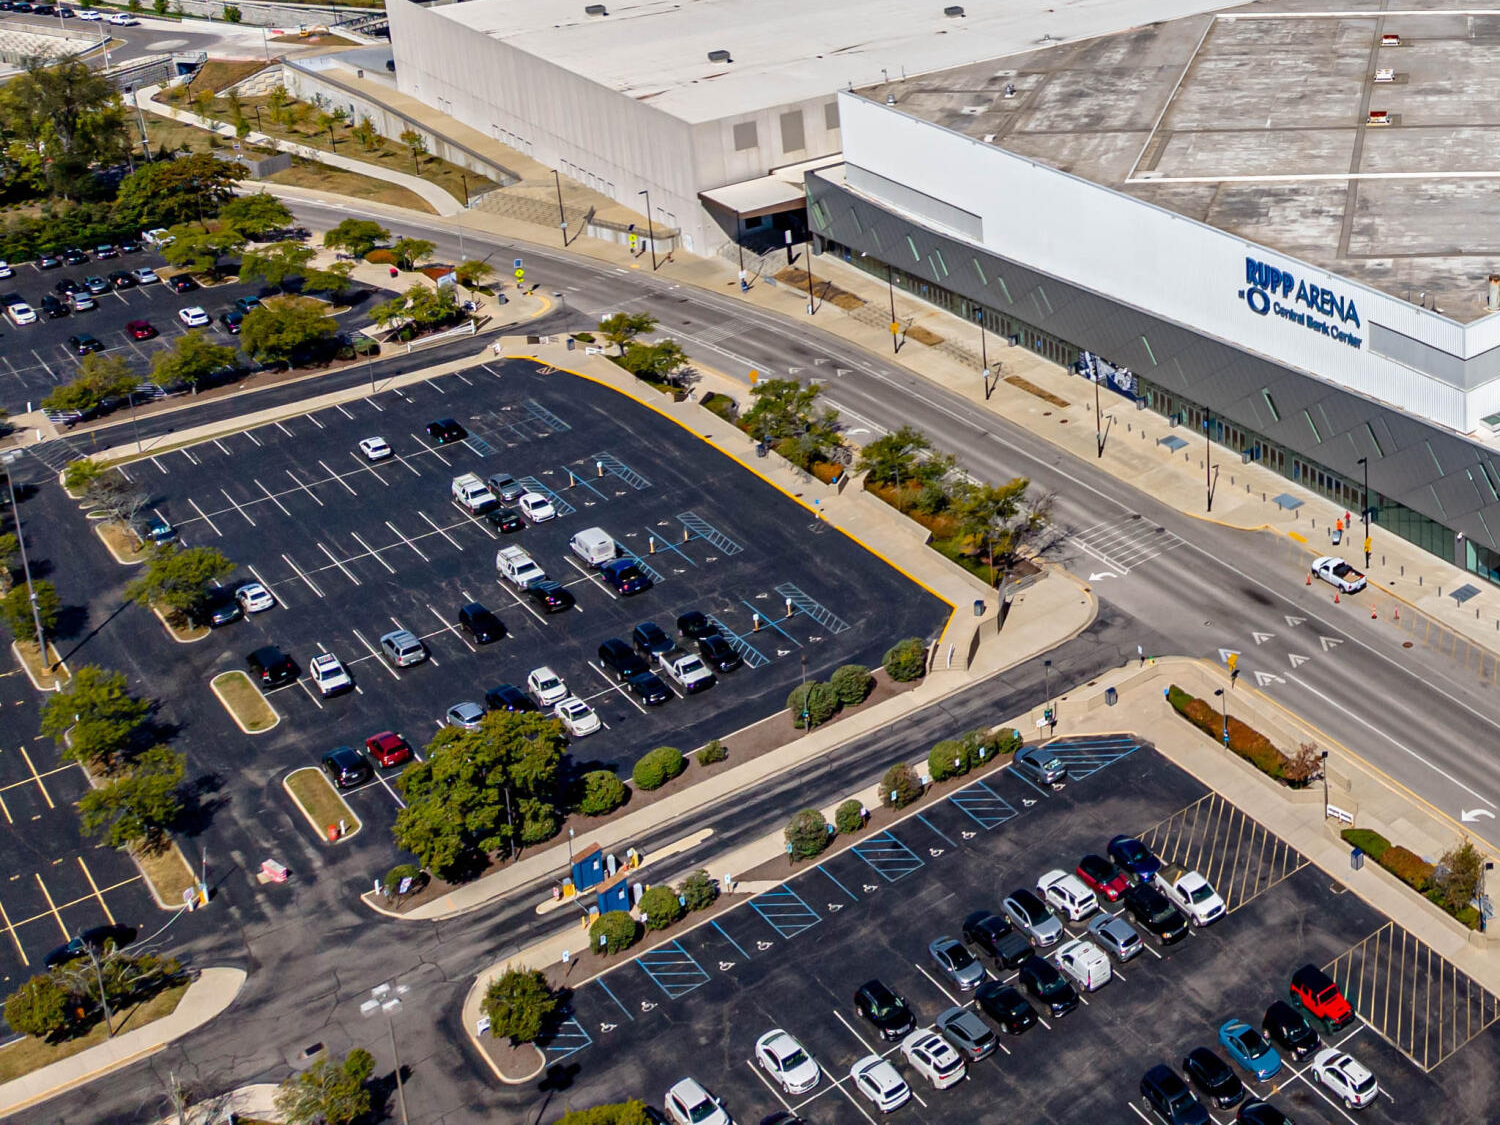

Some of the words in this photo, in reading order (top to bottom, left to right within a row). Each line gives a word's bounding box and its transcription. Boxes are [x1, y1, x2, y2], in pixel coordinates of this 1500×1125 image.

[1245, 256, 1295, 299] RUPP
[1295, 279, 1361, 329] ARENA
[1273, 301, 1305, 326] Central
[1306, 314, 1330, 337] Bank
[1330, 325, 1362, 350] Center
